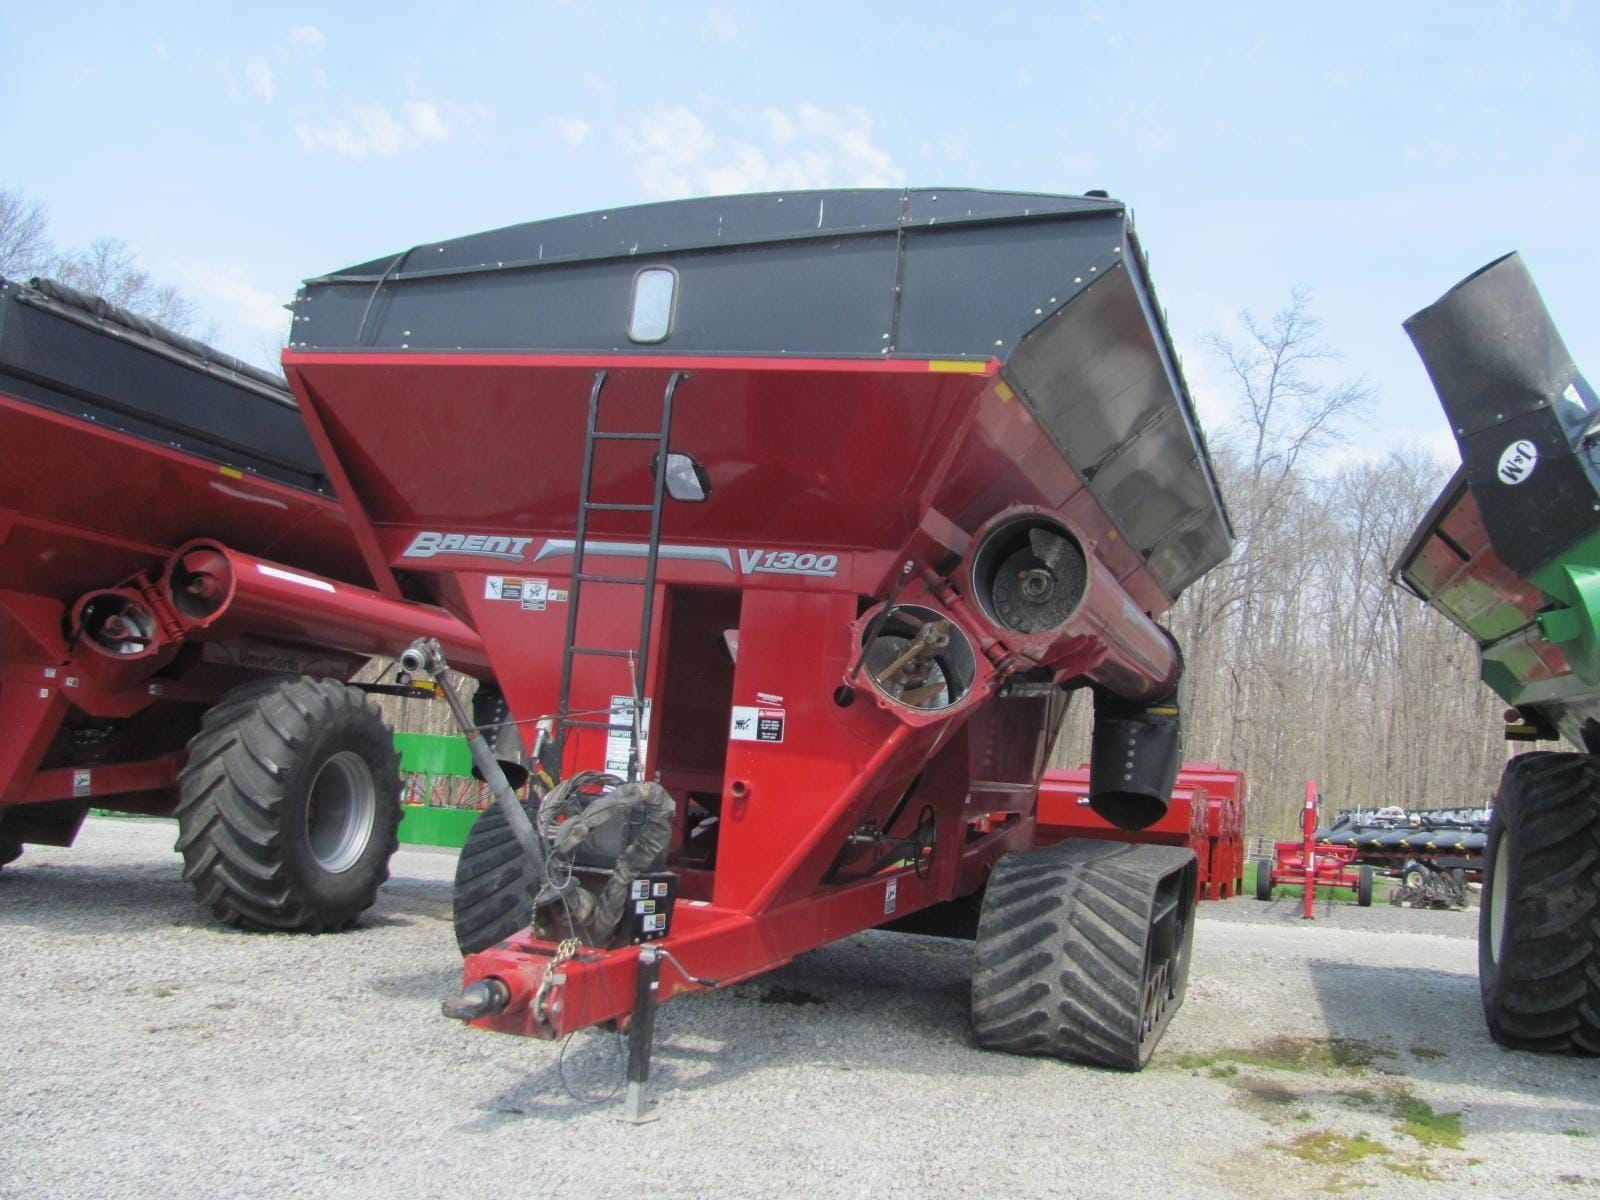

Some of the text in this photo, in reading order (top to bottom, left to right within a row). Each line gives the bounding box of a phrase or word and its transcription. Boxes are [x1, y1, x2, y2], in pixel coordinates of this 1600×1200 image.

[1501, 442, 1532, 482] J&M
[402, 531, 533, 562] BRENT
[738, 548, 838, 577] V1300
[613, 697, 649, 707] IMPORT
